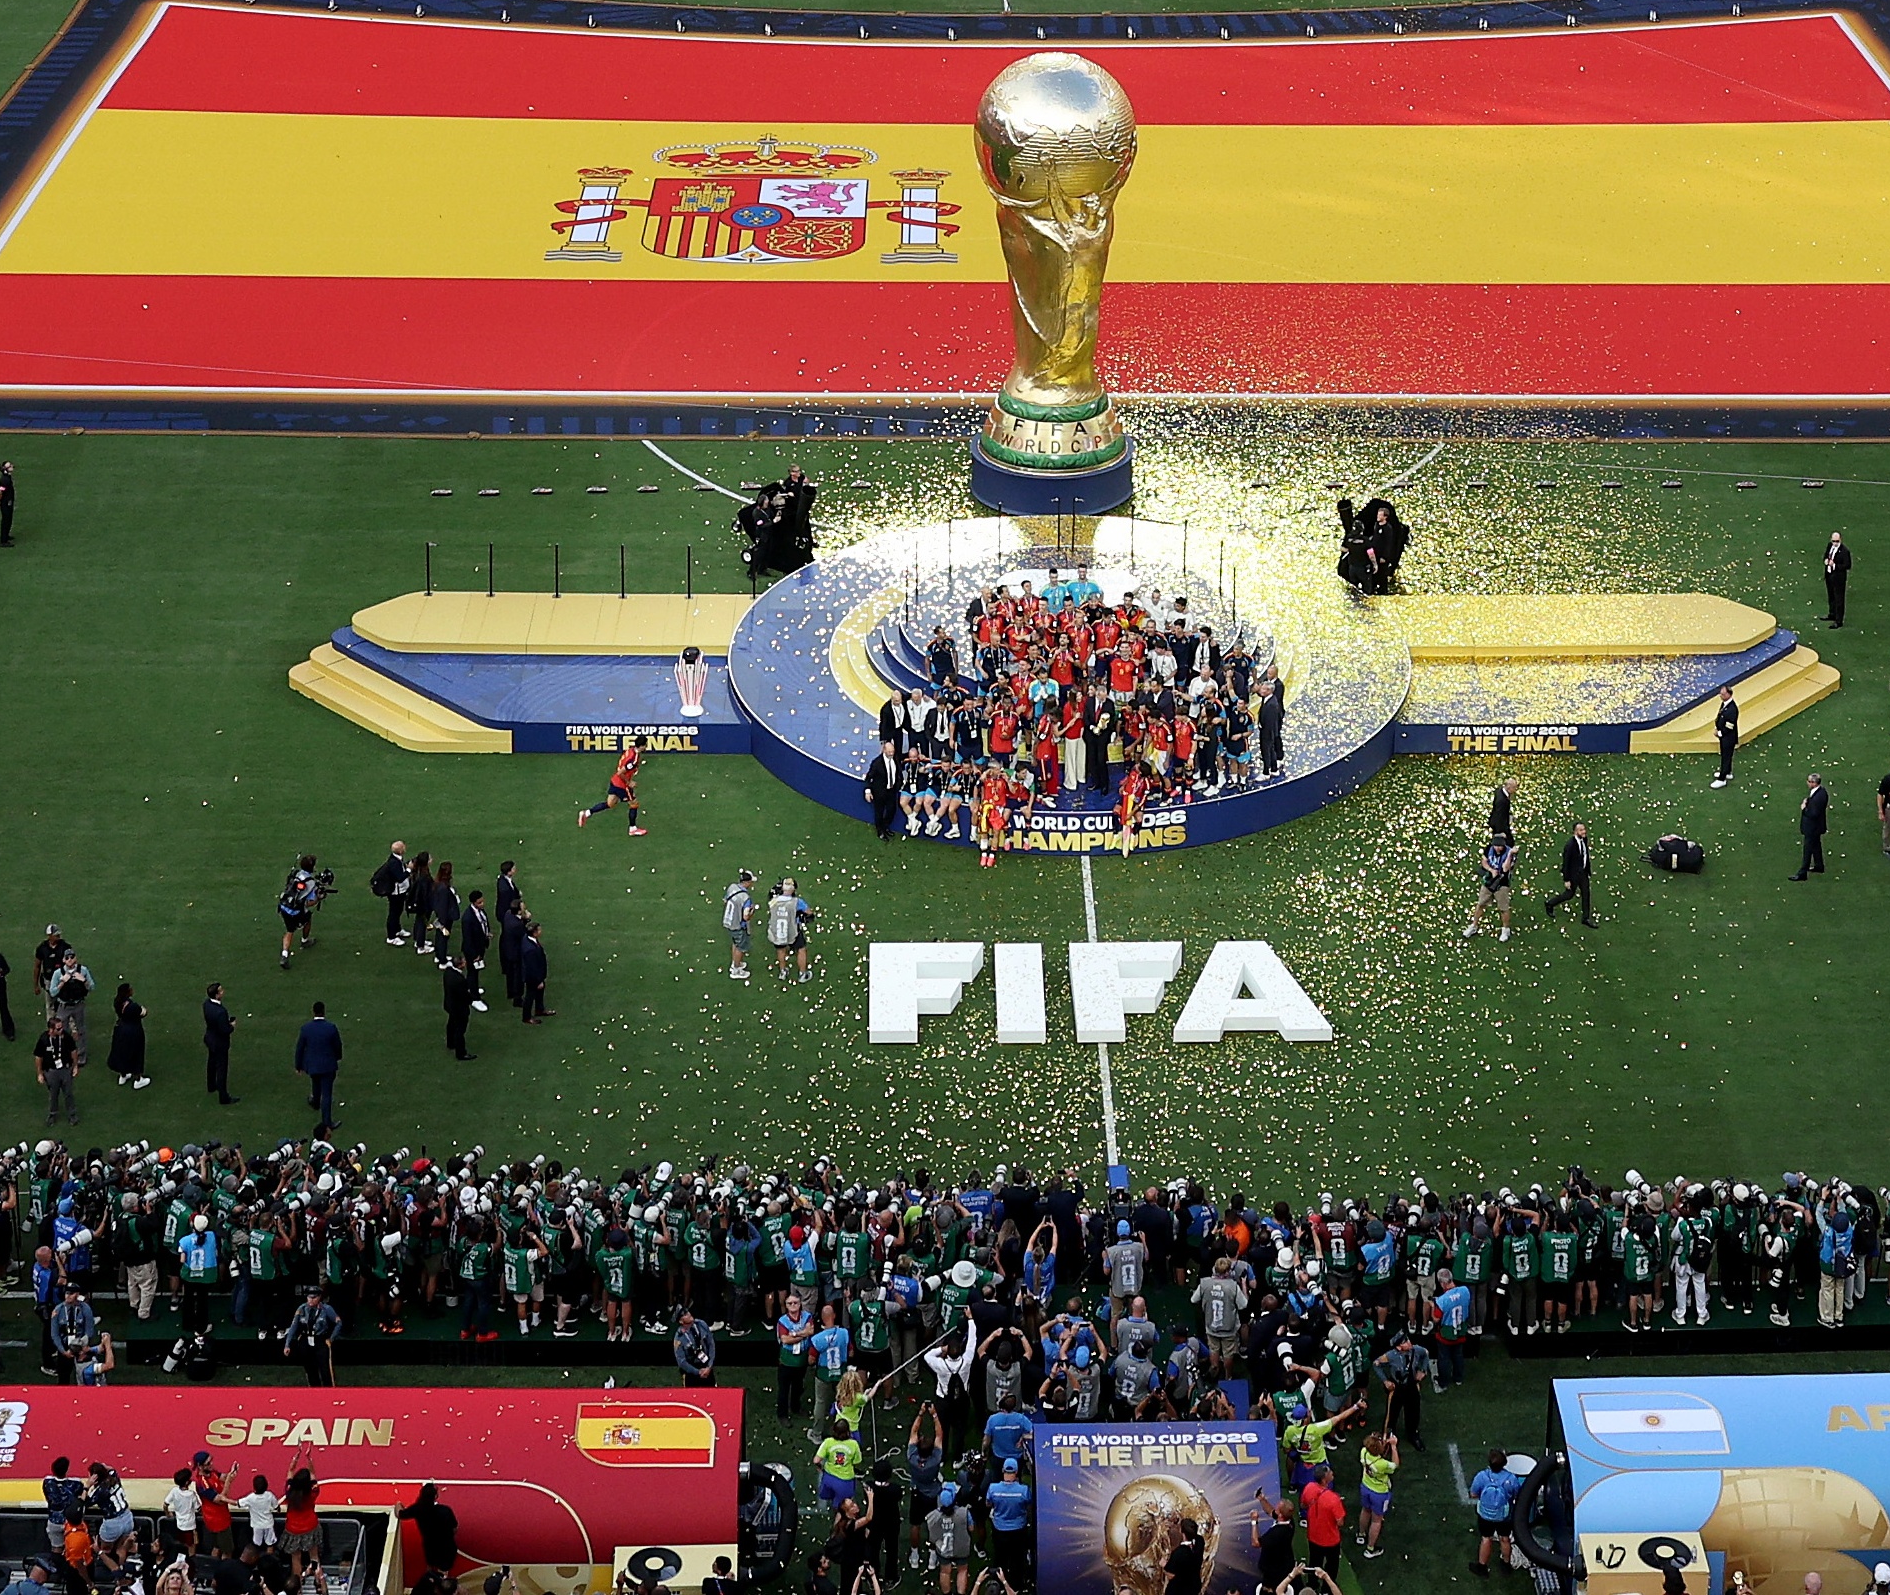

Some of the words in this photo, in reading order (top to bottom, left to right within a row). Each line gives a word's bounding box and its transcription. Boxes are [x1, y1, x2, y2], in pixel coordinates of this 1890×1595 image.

[1013, 419, 1085, 436] FIFA
[999, 434, 1061, 453] WORLD
[1070, 434, 1105, 453] CUP
[566, 726, 591, 735] FIFA
[592, 726, 632, 735] WORLD
[634, 726, 657, 736] CUP
[659, 726, 698, 735] 2026
[1447, 727, 1472, 736] FIFA
[1473, 727, 1514, 736] WORLD
[1515, 727, 1537, 736] CUP
[1539, 727, 1578, 736] 2026
[566, 736, 617, 750] THE
[1448, 736, 1499, 752] THE
[1503, 736, 1577, 752] FINAL
[1140, 811, 1186, 829] 026
[869, 941, 1333, 1044] FIFA
[206, 1418, 394, 1446] SPAIN
[1053, 1433, 1089, 1446] FIFA
[1092, 1433, 1155, 1446] WORLD
[1159, 1433, 1193, 1445] CUP
[1196, 1433, 1257, 1444] 2026
[1053, 1446, 1134, 1466] THE
[1142, 1443, 1259, 1466] FINAL
